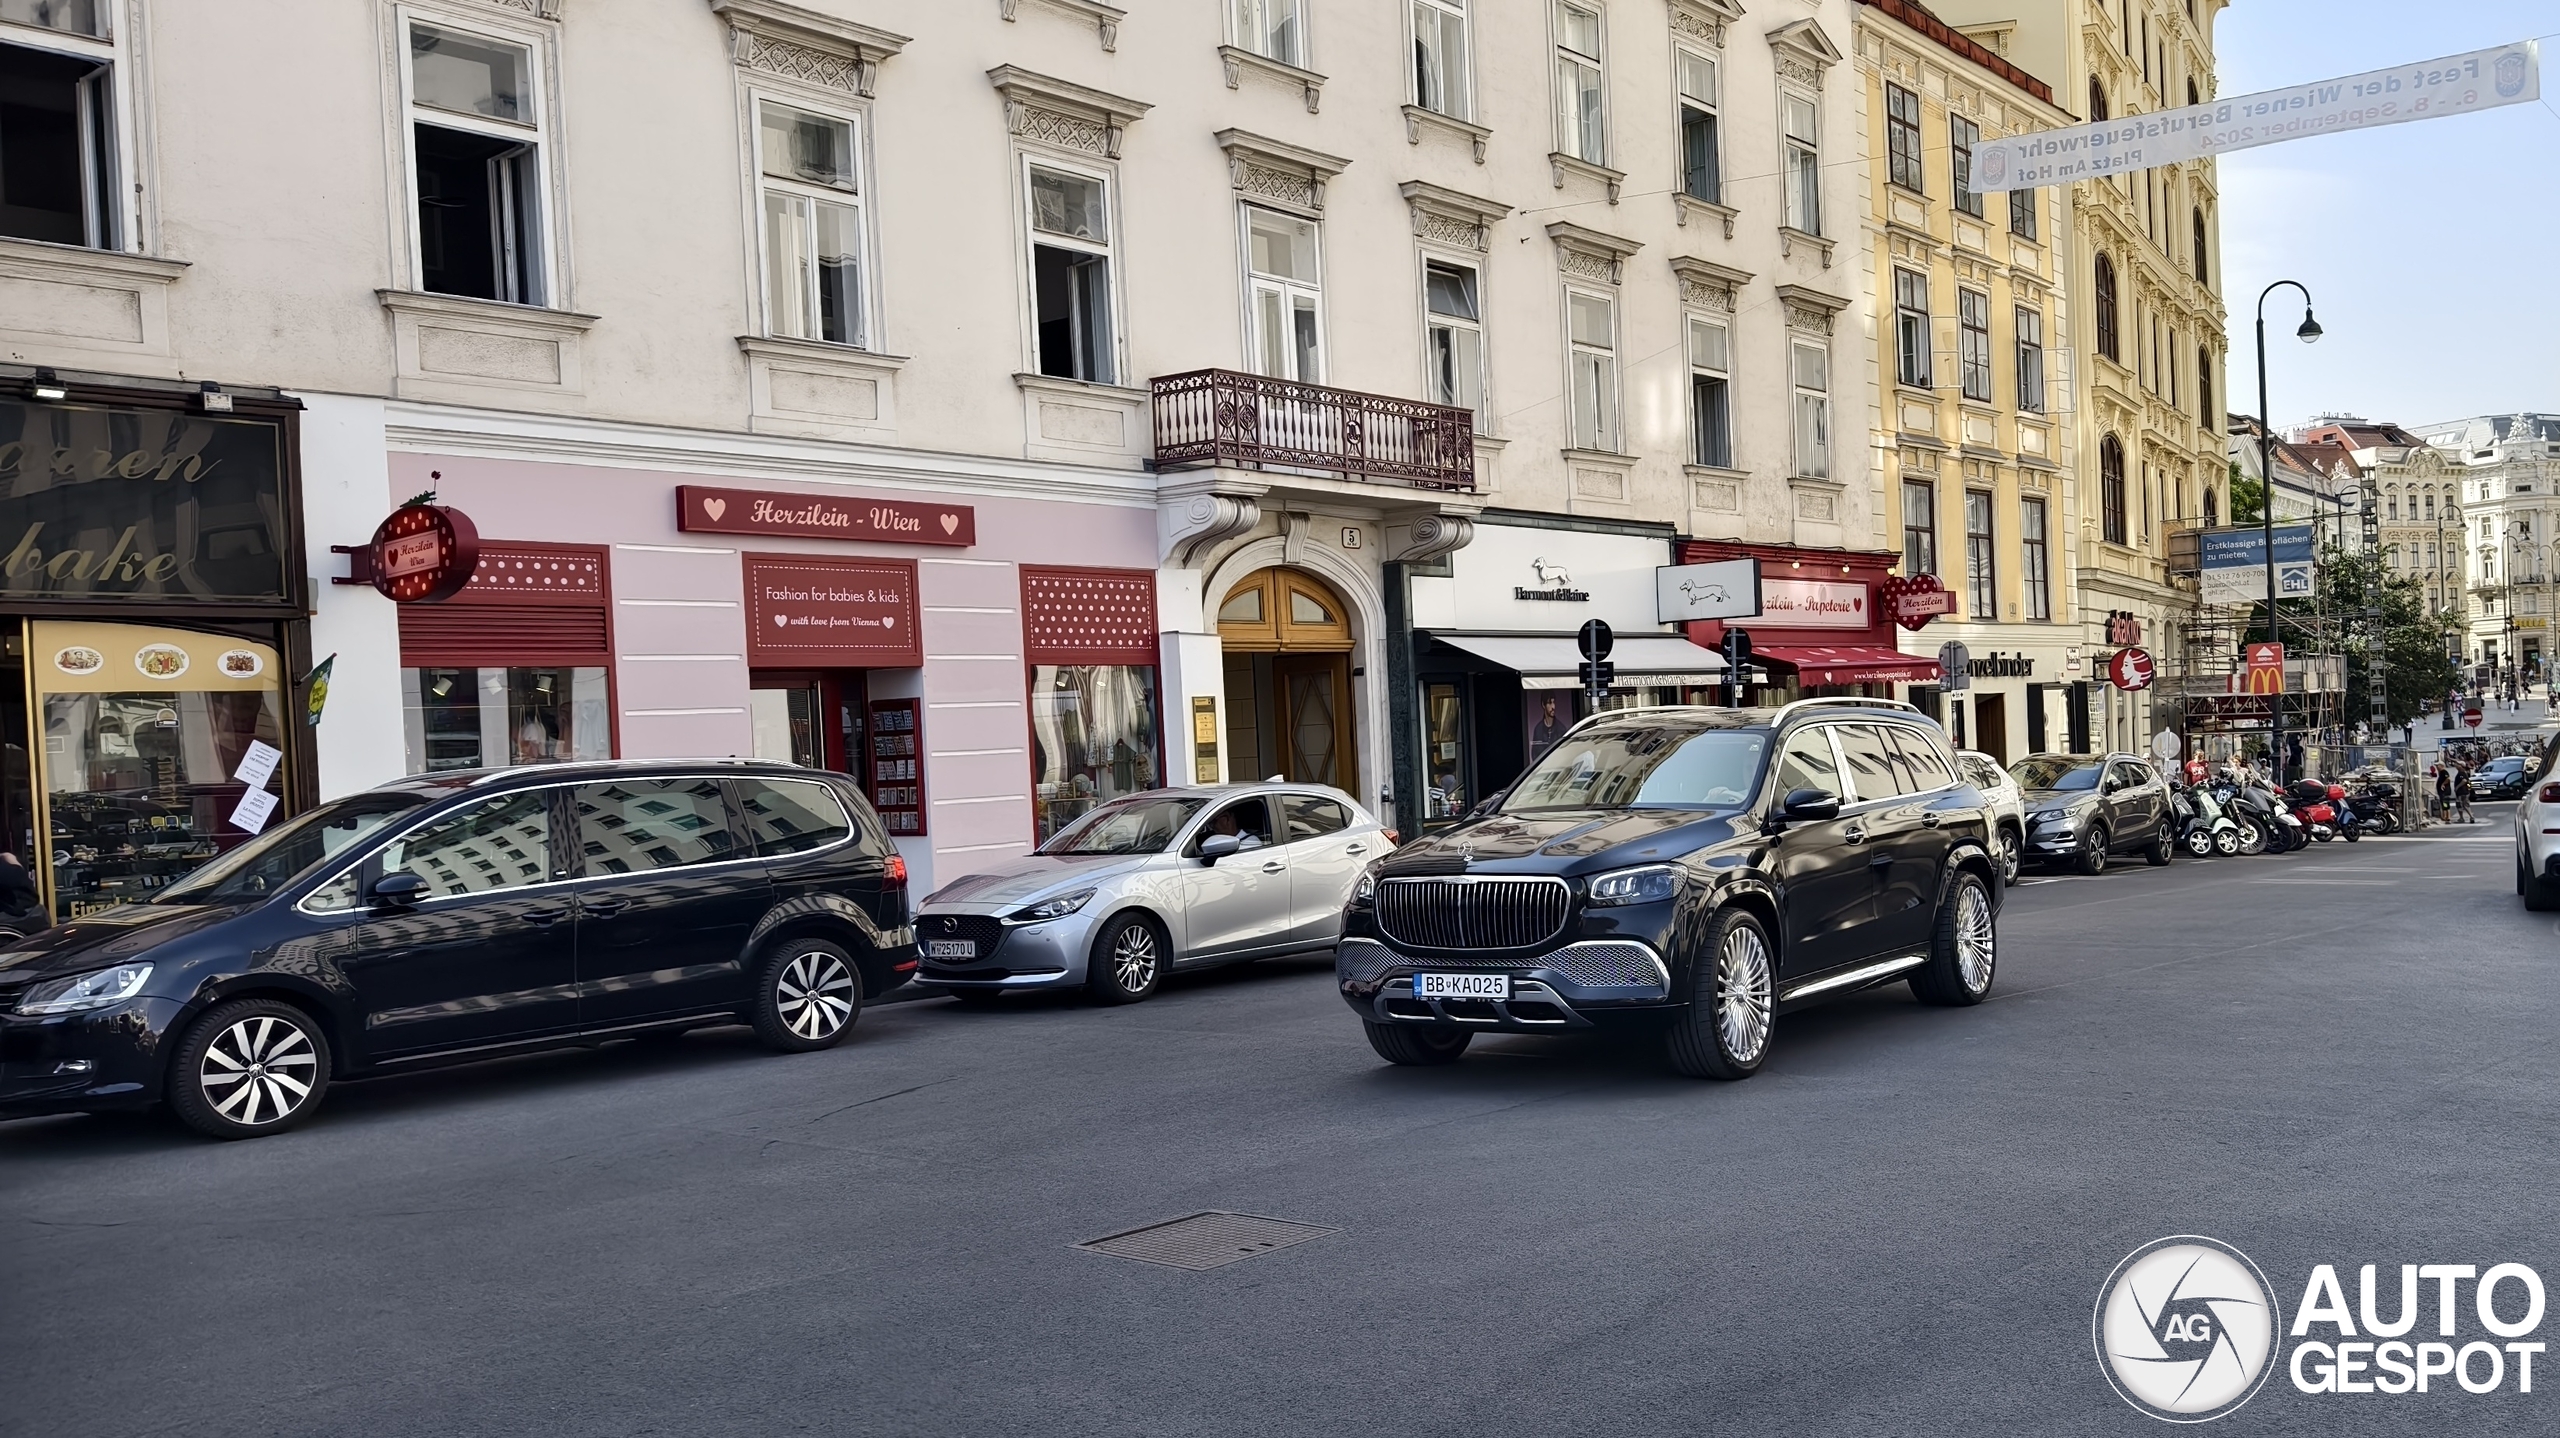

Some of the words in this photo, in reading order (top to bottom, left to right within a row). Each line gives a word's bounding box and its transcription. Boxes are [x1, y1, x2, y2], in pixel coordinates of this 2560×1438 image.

[750, 499, 850, 527] Herzilein
[870, 507, 921, 531] Wien
[1349, 530, 1354, 543] 5
[400, 540, 434, 556] Herzilein
[2207, 540, 2256, 550] Erstklassige
[0, 522, 195, 582] bake
[2219, 552, 2249, 560] mieten.
[2283, 579, 2308, 590] EHL
[766, 586, 808, 601] Fashion
[811, 586, 827, 601] for
[829, 587, 865, 602] babies
[868, 590, 877, 602] &
[879, 589, 899, 603] kids
[1804, 596, 1851, 616] Papeterie
[1903, 597, 1943, 608] Herzilein
[790, 616, 809, 626] with
[810, 616, 828, 626] love
[829, 617, 849, 628] from
[852, 617, 880, 626] Vienna
